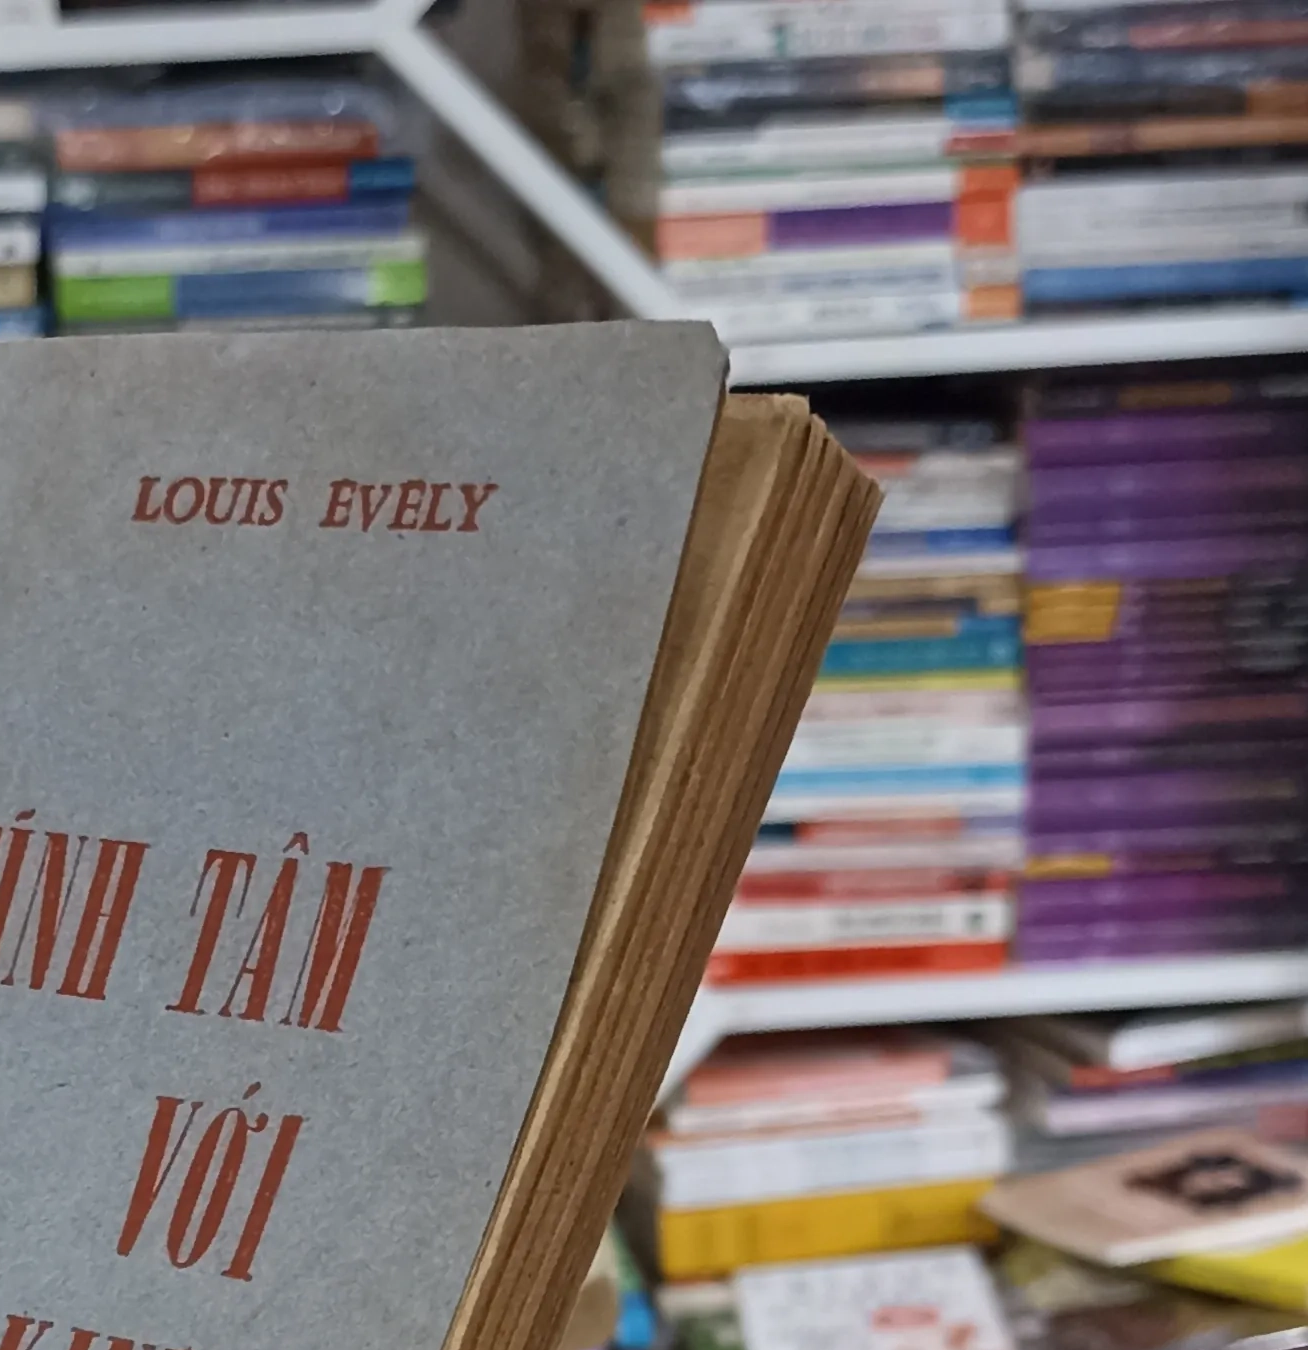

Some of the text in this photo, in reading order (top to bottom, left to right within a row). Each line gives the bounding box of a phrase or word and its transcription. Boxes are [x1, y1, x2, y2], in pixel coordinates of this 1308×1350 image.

[131, 475, 289, 527] LOUIS
[165, 831, 393, 1034] TÂM
[115, 1080, 305, 1282] VỚI
